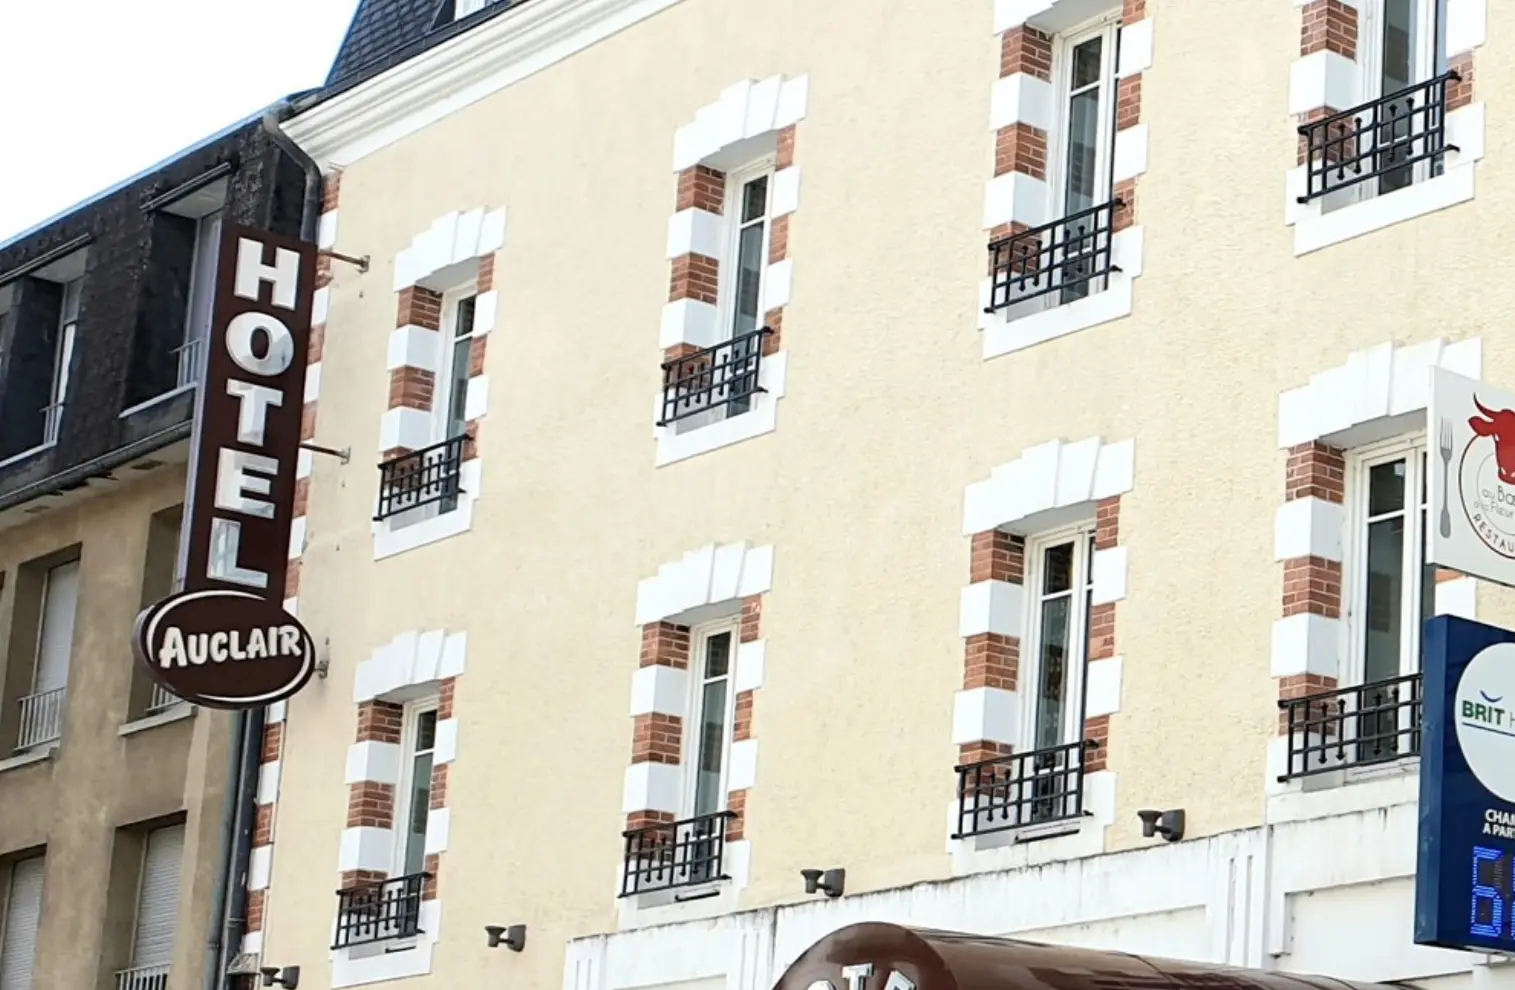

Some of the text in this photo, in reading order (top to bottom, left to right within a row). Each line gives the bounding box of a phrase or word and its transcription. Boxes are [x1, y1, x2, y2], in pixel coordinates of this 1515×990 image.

[206, 236, 300, 590] HOTEL
[159, 624, 303, 669] AUCLAIR
[1462, 699, 1505, 726] BRIT
